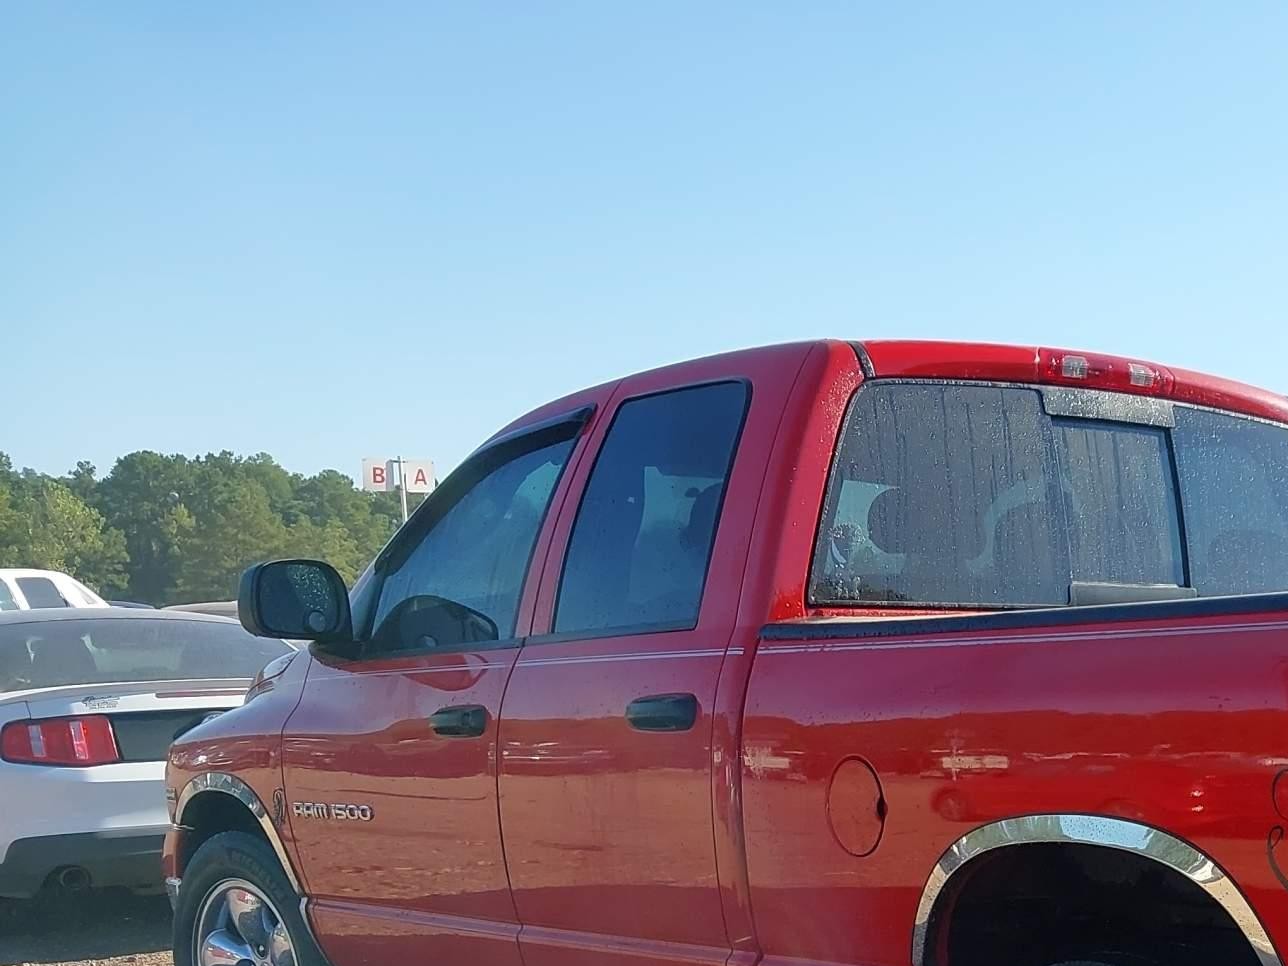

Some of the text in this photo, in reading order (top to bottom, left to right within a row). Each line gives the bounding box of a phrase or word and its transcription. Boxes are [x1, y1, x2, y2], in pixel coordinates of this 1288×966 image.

[372, 467, 385, 484] B
[414, 468, 427, 485] A
[292, 801, 374, 822] RAM 1500
